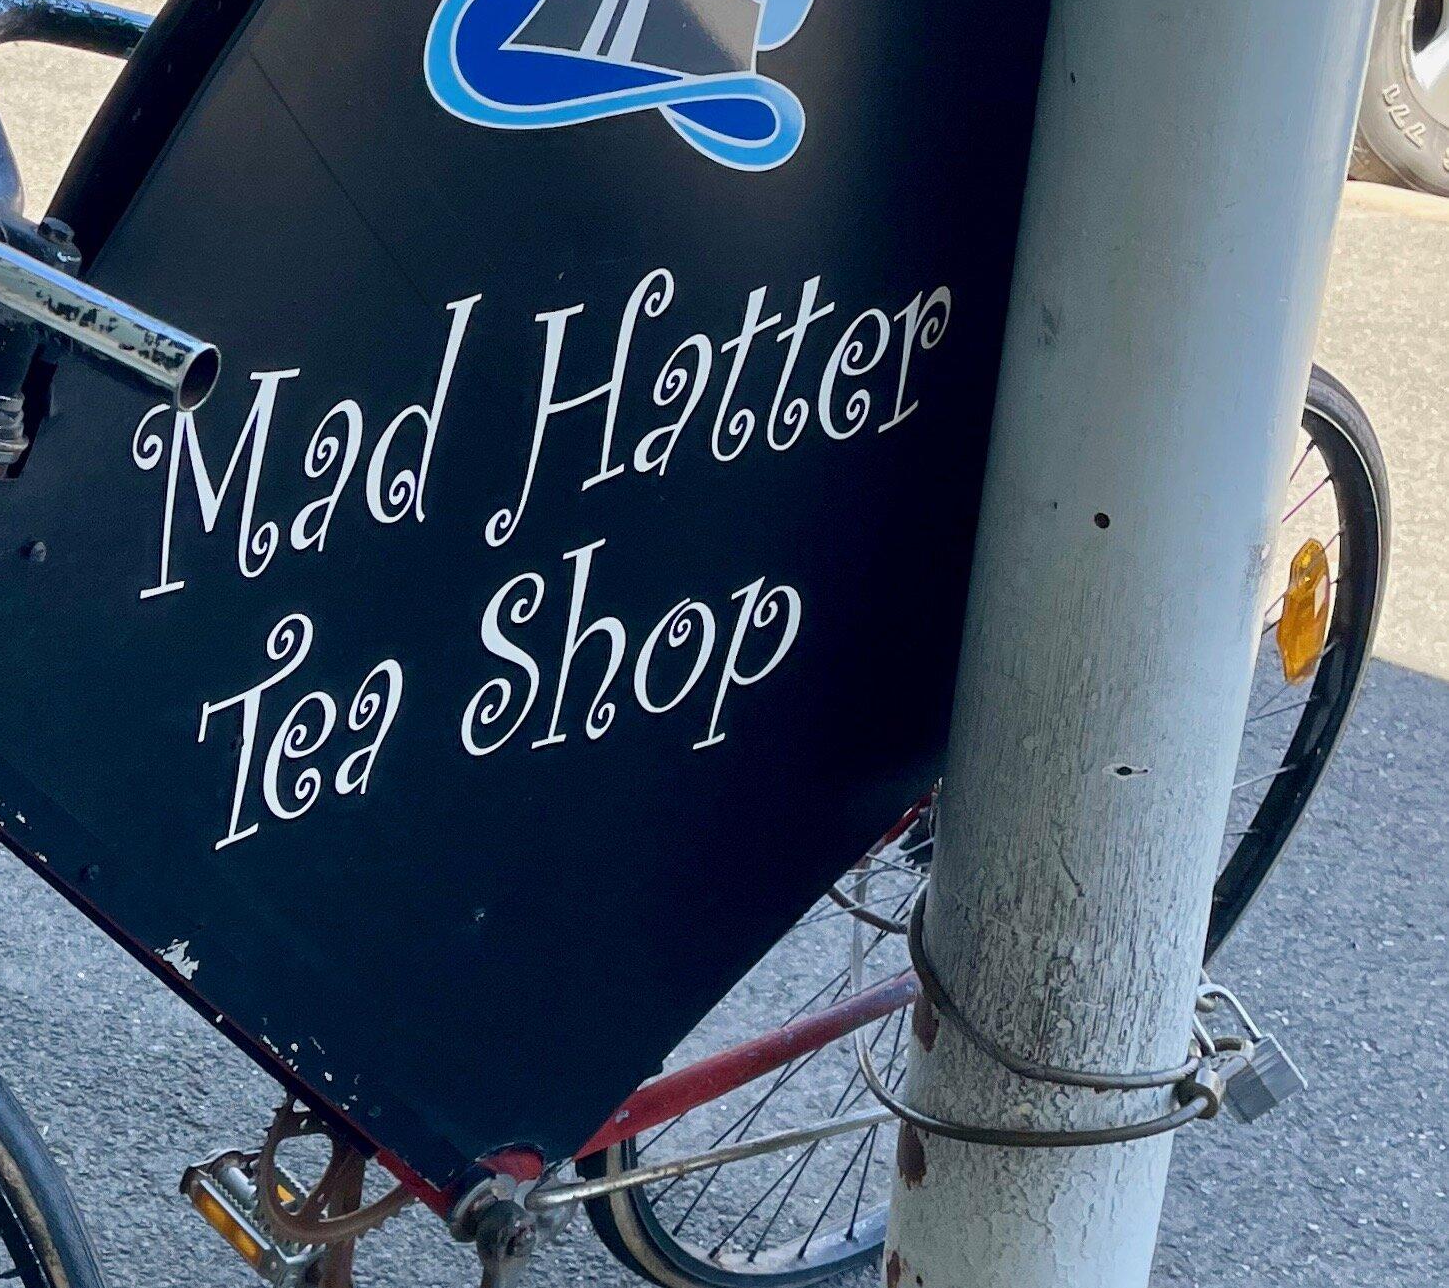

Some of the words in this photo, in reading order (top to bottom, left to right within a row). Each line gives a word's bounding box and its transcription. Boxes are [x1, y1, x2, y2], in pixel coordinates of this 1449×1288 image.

[133, 294, 482, 599] Mad
[485, 267, 953, 547] Hatter
[198, 613, 404, 851] Tea
[461, 539, 801, 757] Shop
